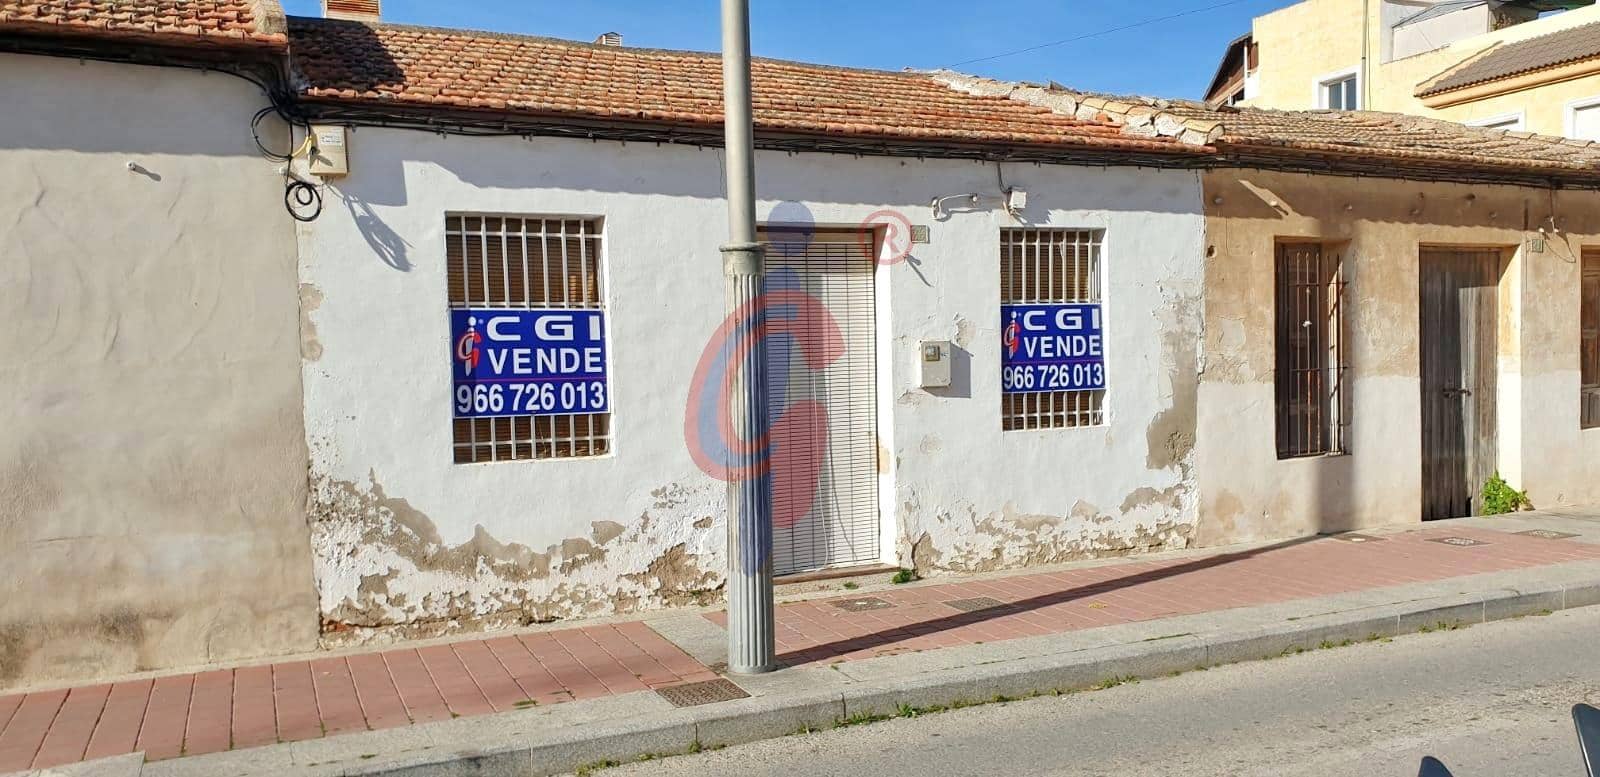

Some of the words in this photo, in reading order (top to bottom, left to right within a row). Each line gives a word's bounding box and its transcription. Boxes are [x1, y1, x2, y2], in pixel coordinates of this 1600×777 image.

[486, 315, 601, 341] CGI
[1023, 308, 1100, 331] CGI
[1023, 334, 1101, 358] VENDE
[488, 347, 602, 375] VENDE
[1003, 365, 1035, 389] 966
[1037, 364, 1070, 388] 726
[1073, 362, 1104, 386] 013
[457, 384, 504, 413] 966
[509, 384, 556, 411] 726
[560, 381, 605, 409] 013
